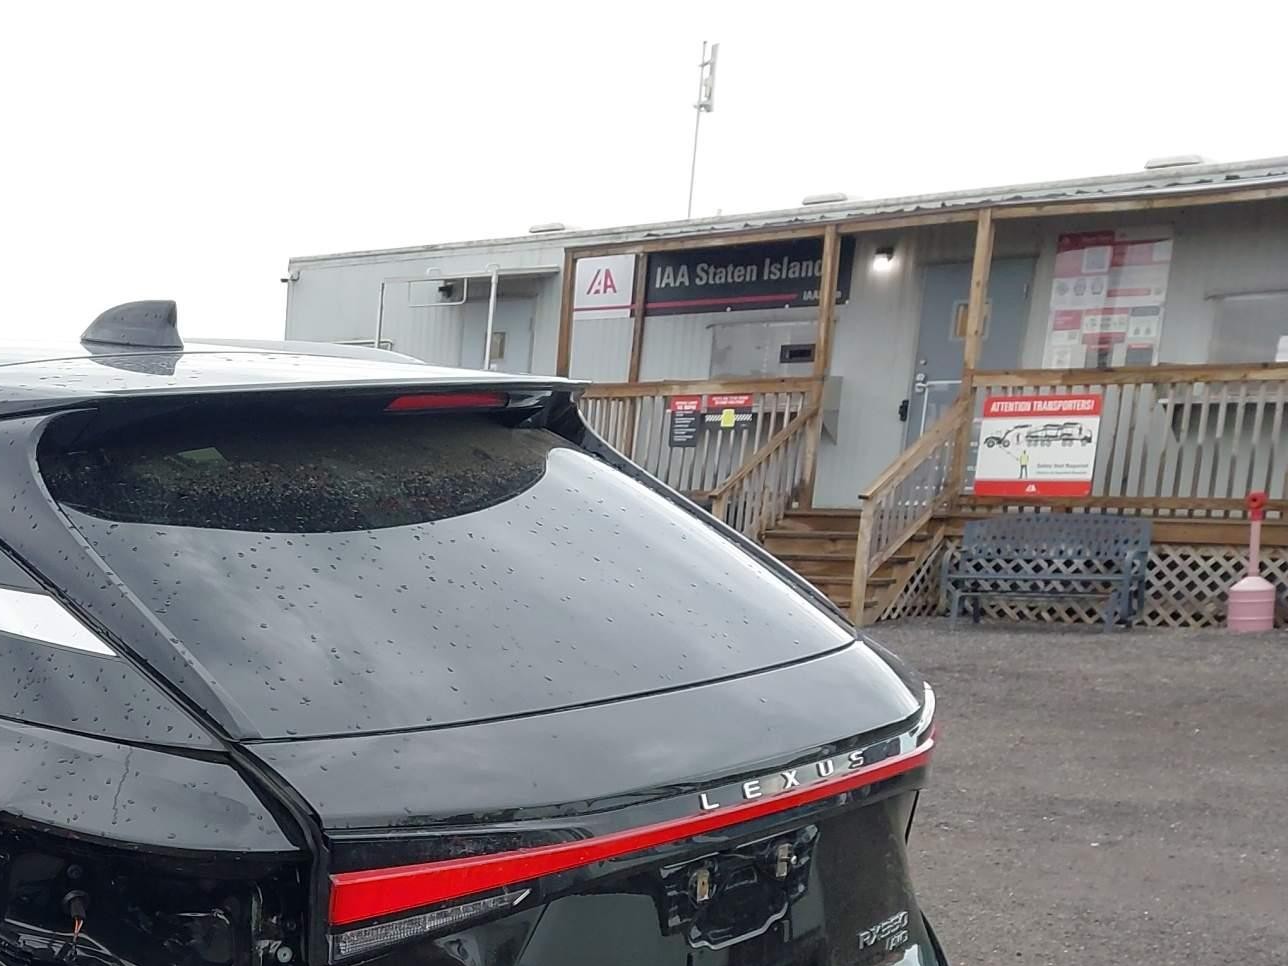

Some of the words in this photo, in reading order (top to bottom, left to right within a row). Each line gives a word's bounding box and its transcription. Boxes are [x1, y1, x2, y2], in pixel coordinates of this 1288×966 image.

[655, 264, 690, 289] IAA
[695, 262, 757, 286] Staten
[990, 401, 1032, 413] ATTENTION
[699, 750, 864, 810] LEXUS
